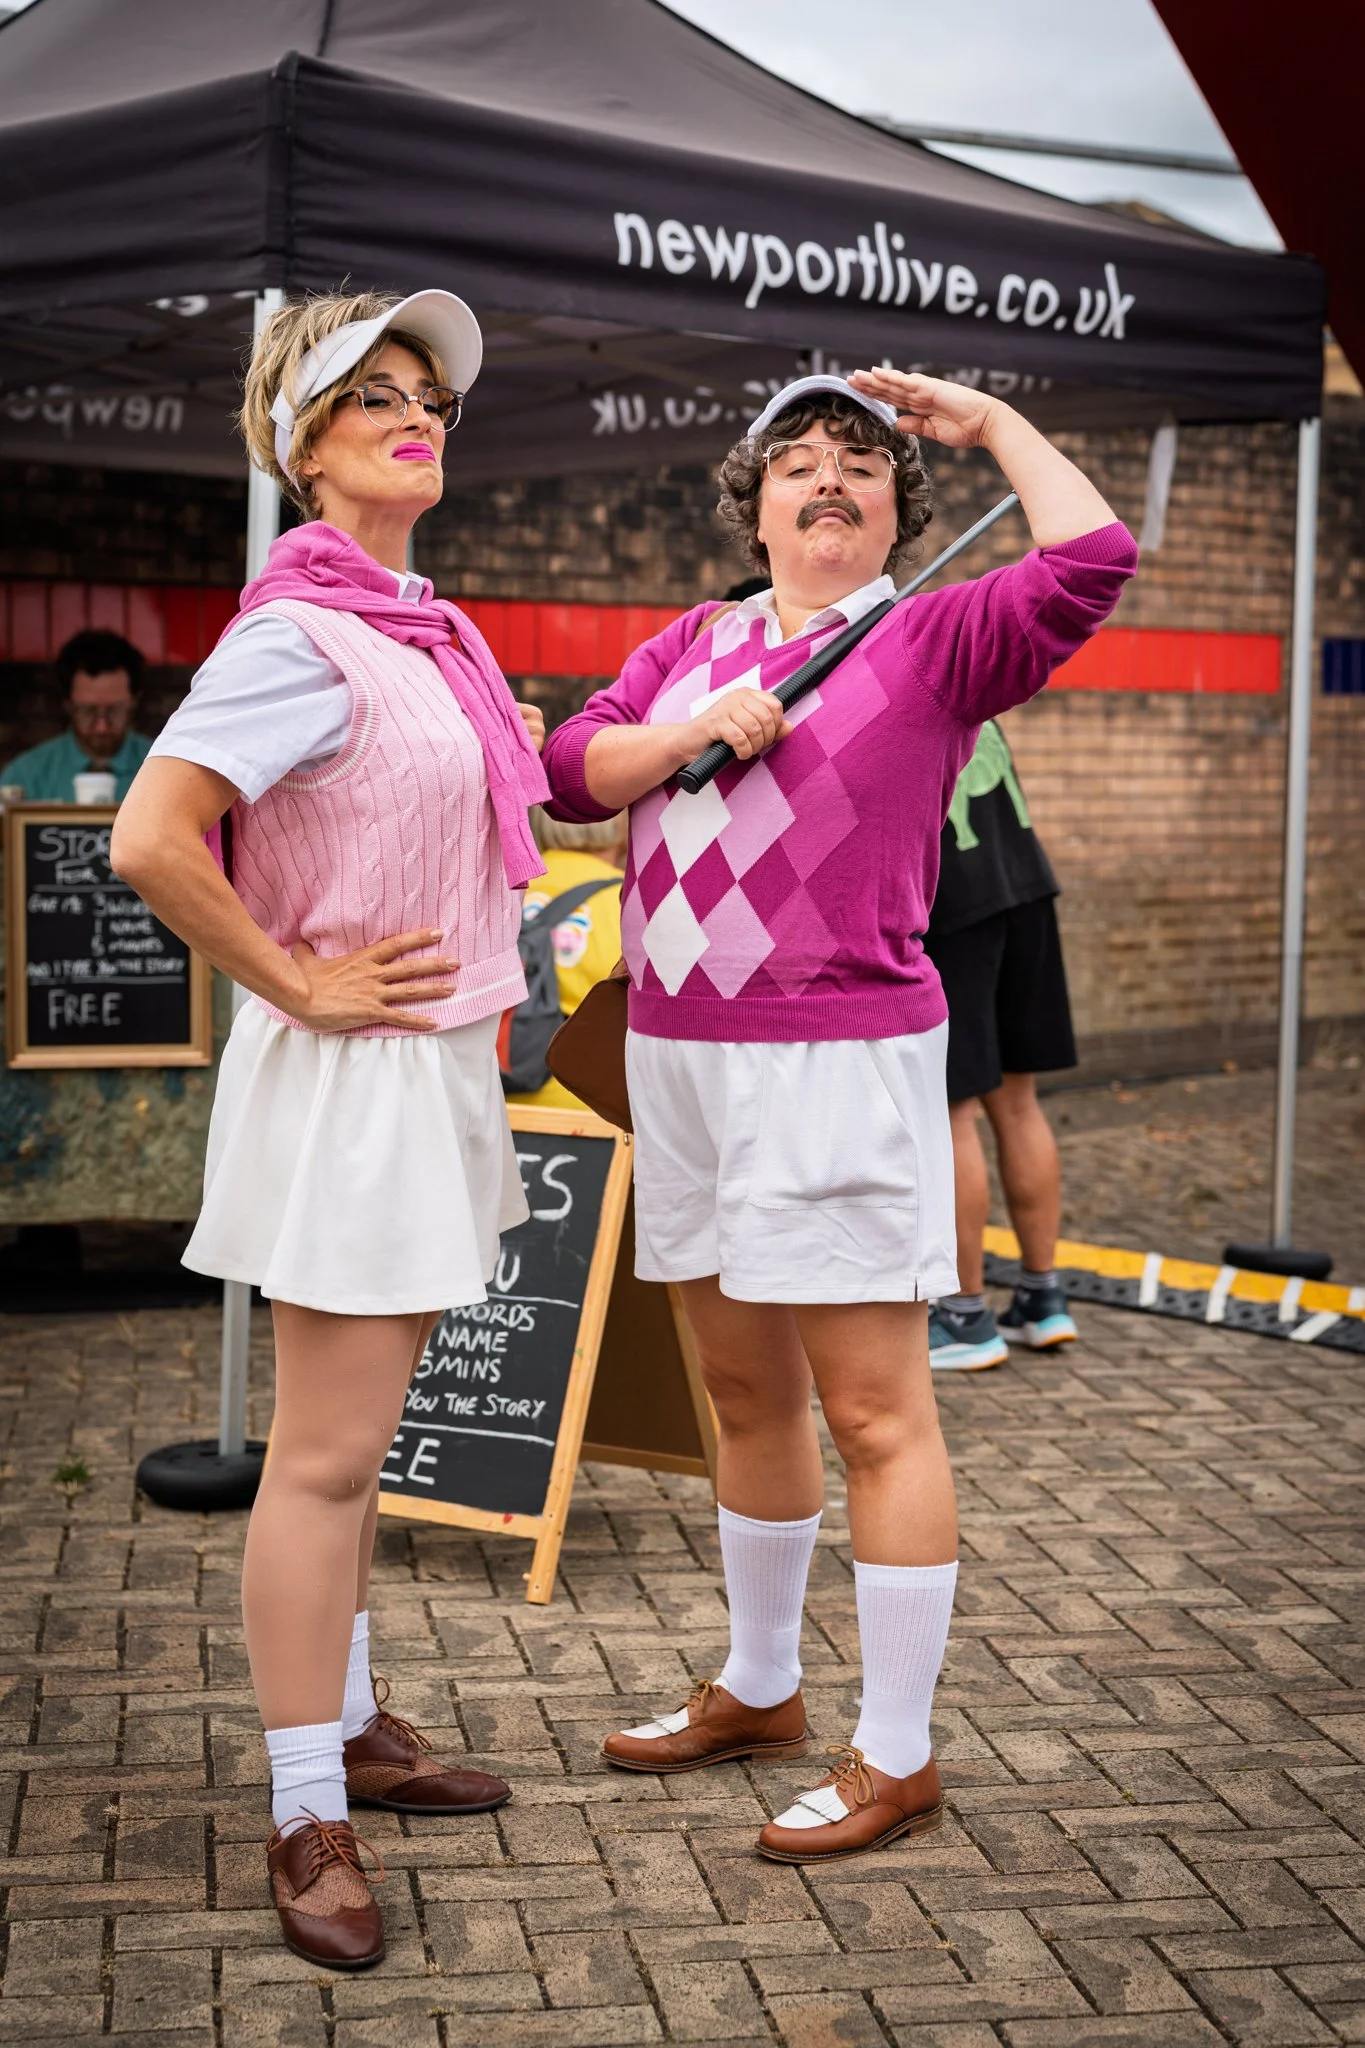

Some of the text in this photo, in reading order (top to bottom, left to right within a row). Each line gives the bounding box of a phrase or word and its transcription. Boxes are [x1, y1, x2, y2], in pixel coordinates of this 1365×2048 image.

[613, 211, 1135, 341] newportlive.co.uk
[48, 989, 122, 1030] FREE
[448, 1302, 538, 1332] WORDS
[437, 1325, 509, 1353] NAME
[405, 1387, 547, 1419] YOU THE STORY
